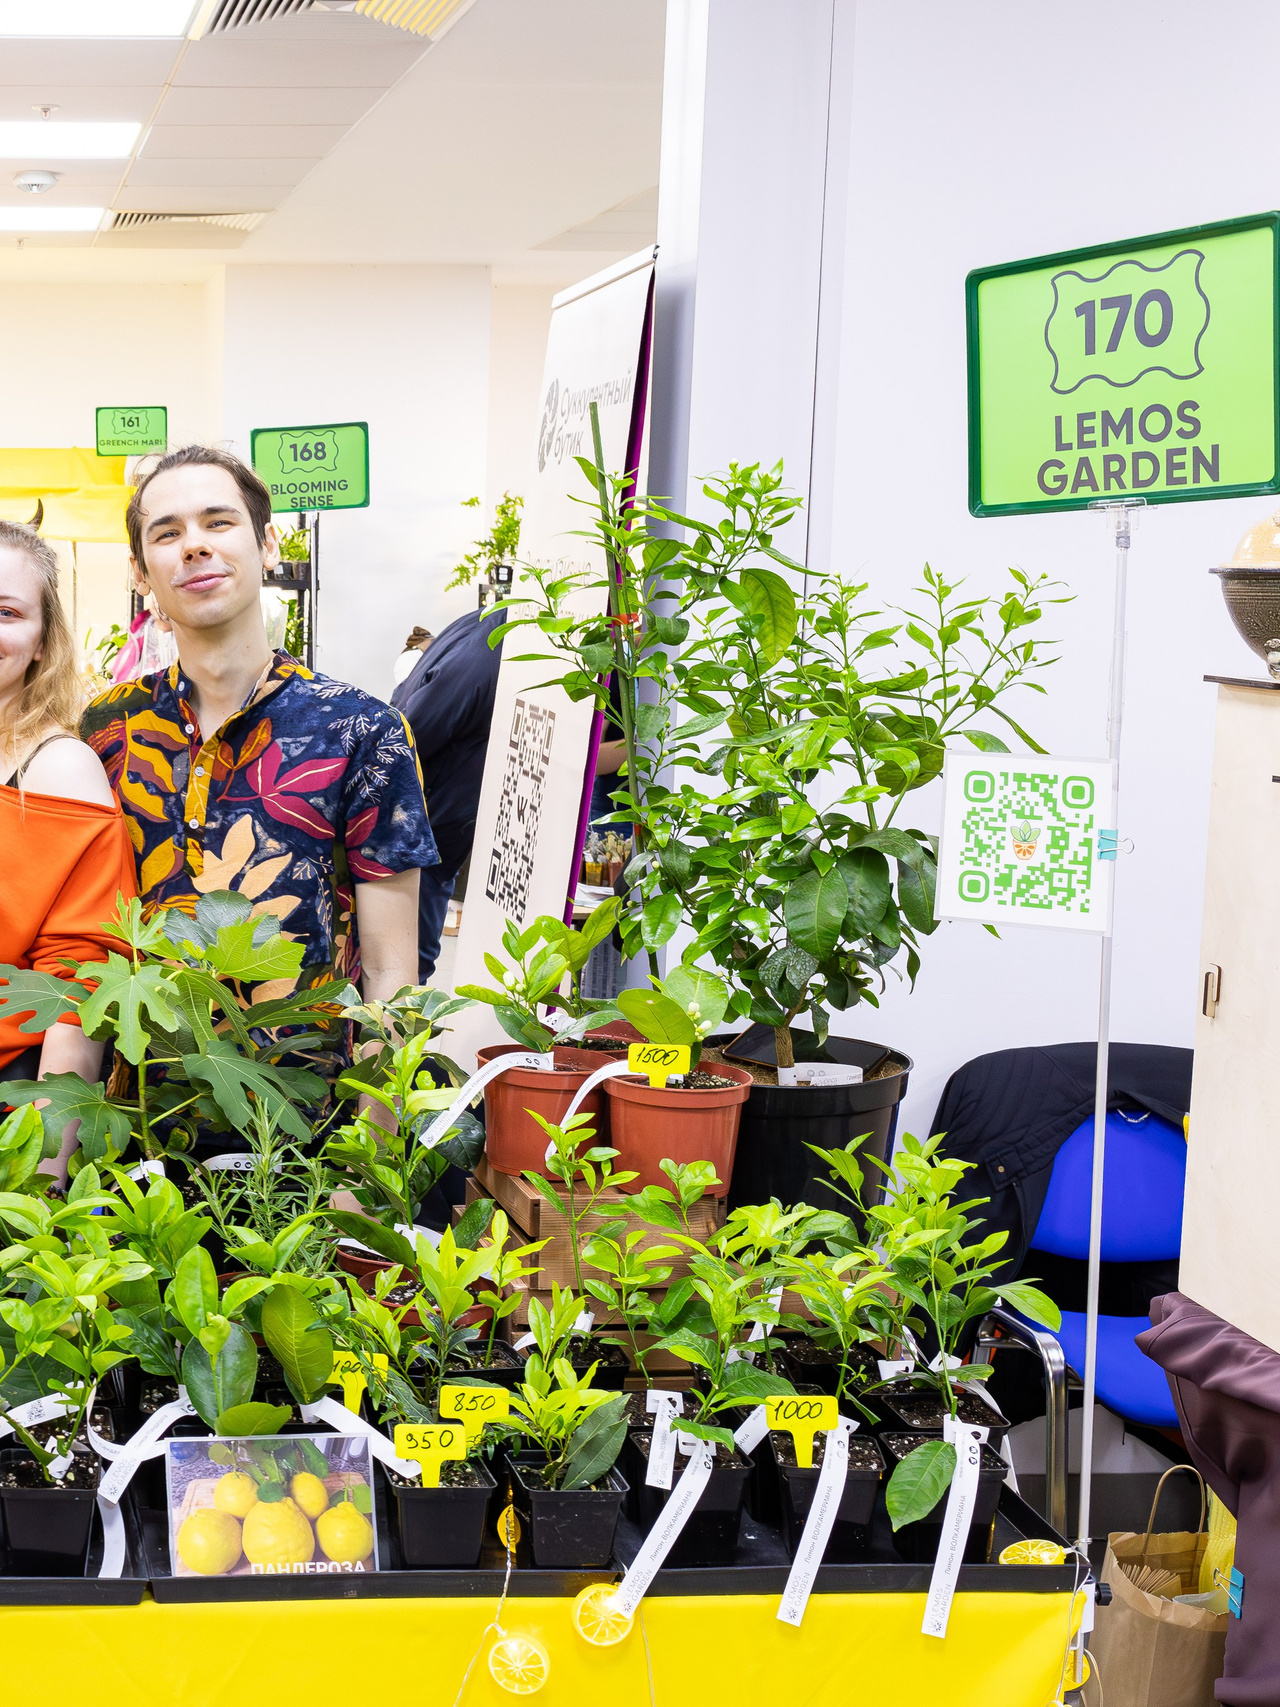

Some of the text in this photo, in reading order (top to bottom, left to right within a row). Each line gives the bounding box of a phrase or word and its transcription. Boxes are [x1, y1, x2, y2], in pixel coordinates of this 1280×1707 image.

[1074, 288, 1174, 356] 170
[120, 416, 140, 428] 161
[1054, 400, 1202, 452] LEMOS
[99, 439, 139, 447] GREENCH
[289, 441, 327, 462] 168
[554, 425, 584, 465] бутик
[1037, 443, 1220, 496] GARDEN
[270, 479, 349, 496] BLOOMING
[290, 494, 334, 508] SENSE
[636, 1046, 679, 1066] 1500
[333, 1359, 366, 1375] 100
[453, 1392, 496, 1412] 850
[774, 1400, 823, 1421] 1000
[406, 1430, 454, 1449] 950
